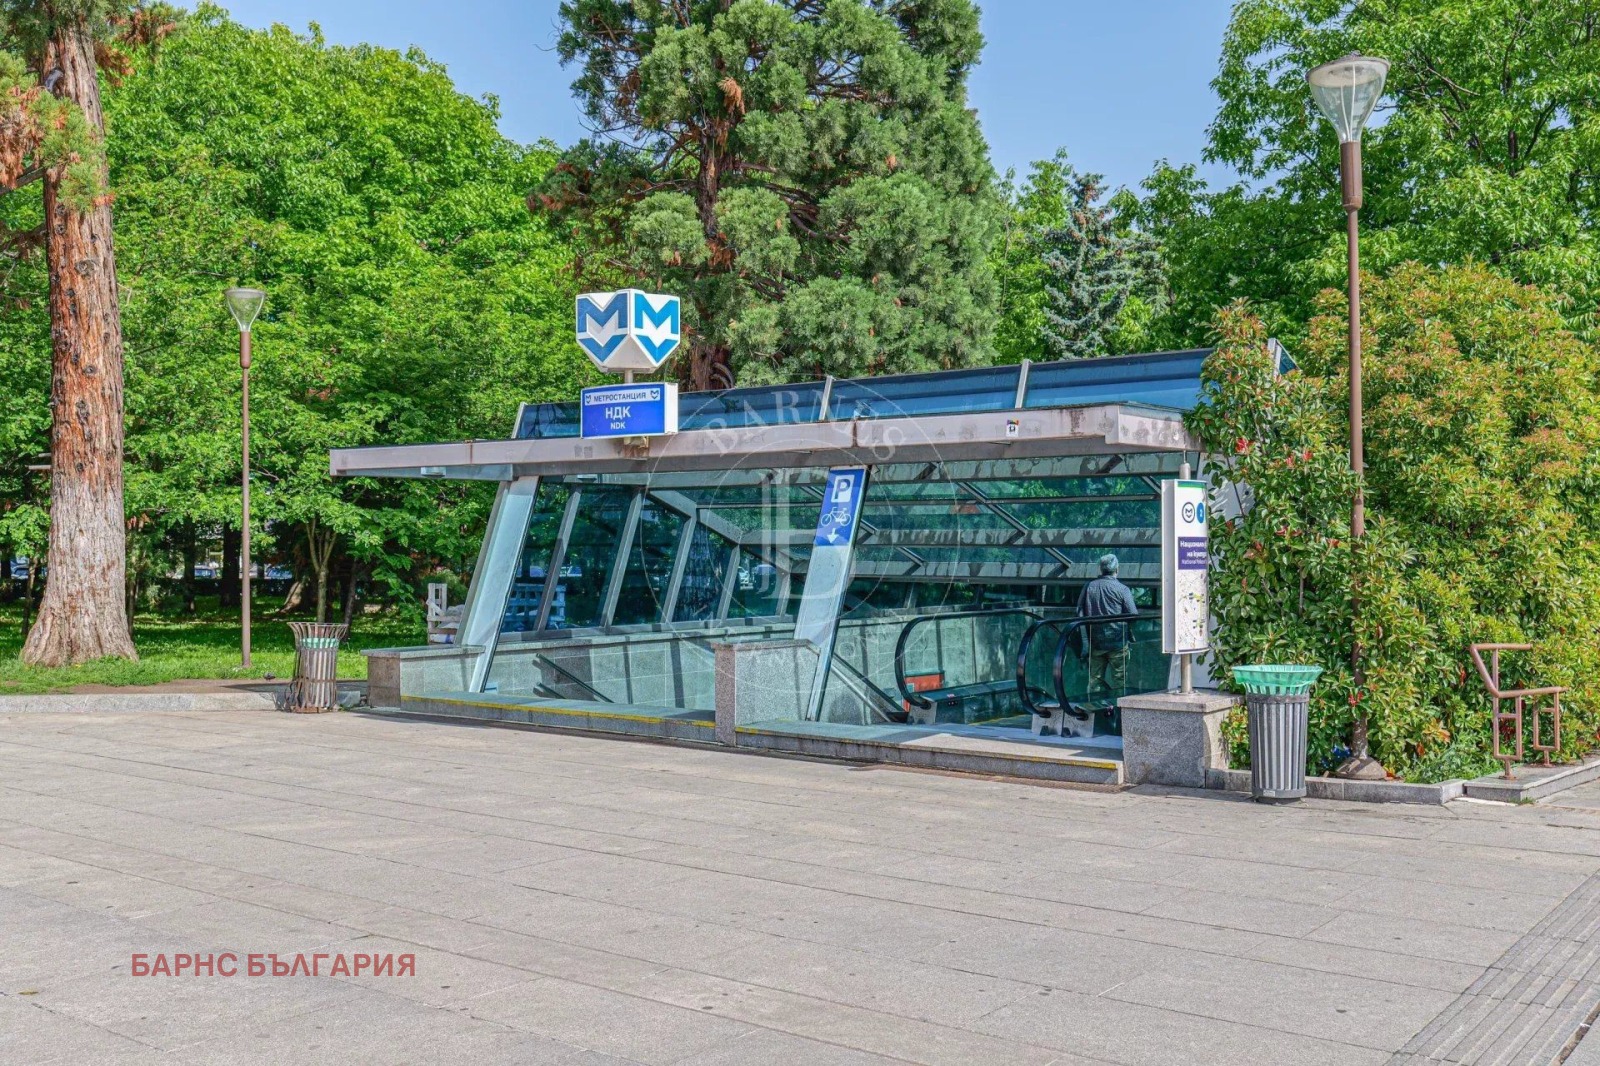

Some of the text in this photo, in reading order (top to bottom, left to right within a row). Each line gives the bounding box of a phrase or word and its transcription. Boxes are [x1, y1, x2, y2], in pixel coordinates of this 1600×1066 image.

[593, 392, 646, 402] МЕТРОСТАНЦИЯ
[605, 405, 631, 420] НДК
[610, 421, 626, 430] NDK
[834, 478, 851, 500] P
